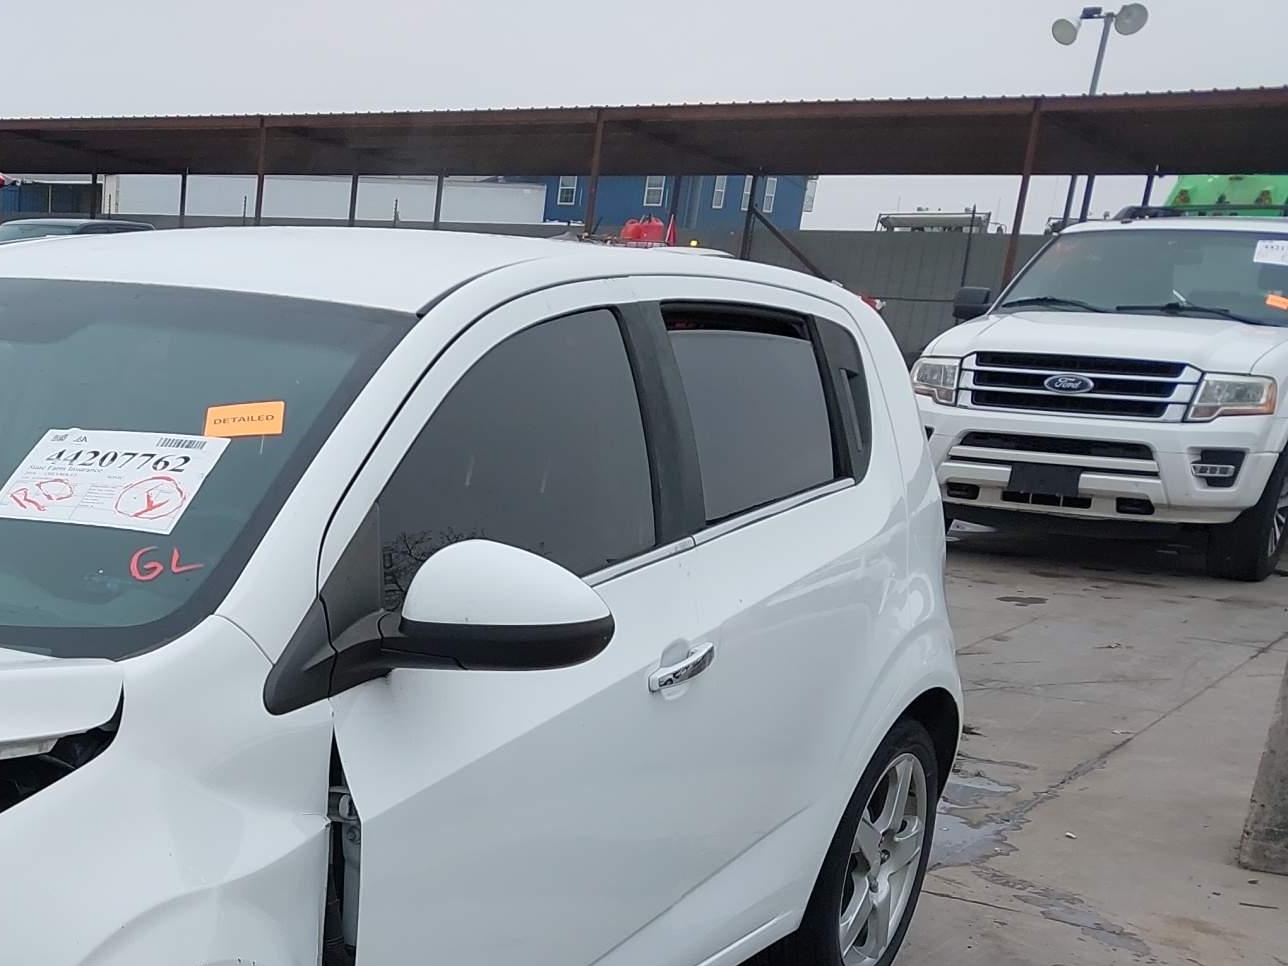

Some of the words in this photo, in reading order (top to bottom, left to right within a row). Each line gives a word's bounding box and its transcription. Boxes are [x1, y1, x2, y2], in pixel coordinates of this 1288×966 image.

[1054, 377, 1082, 389] Ford
[213, 414, 275, 425] DETAILED
[46, 449, 191, 472] 44207762
